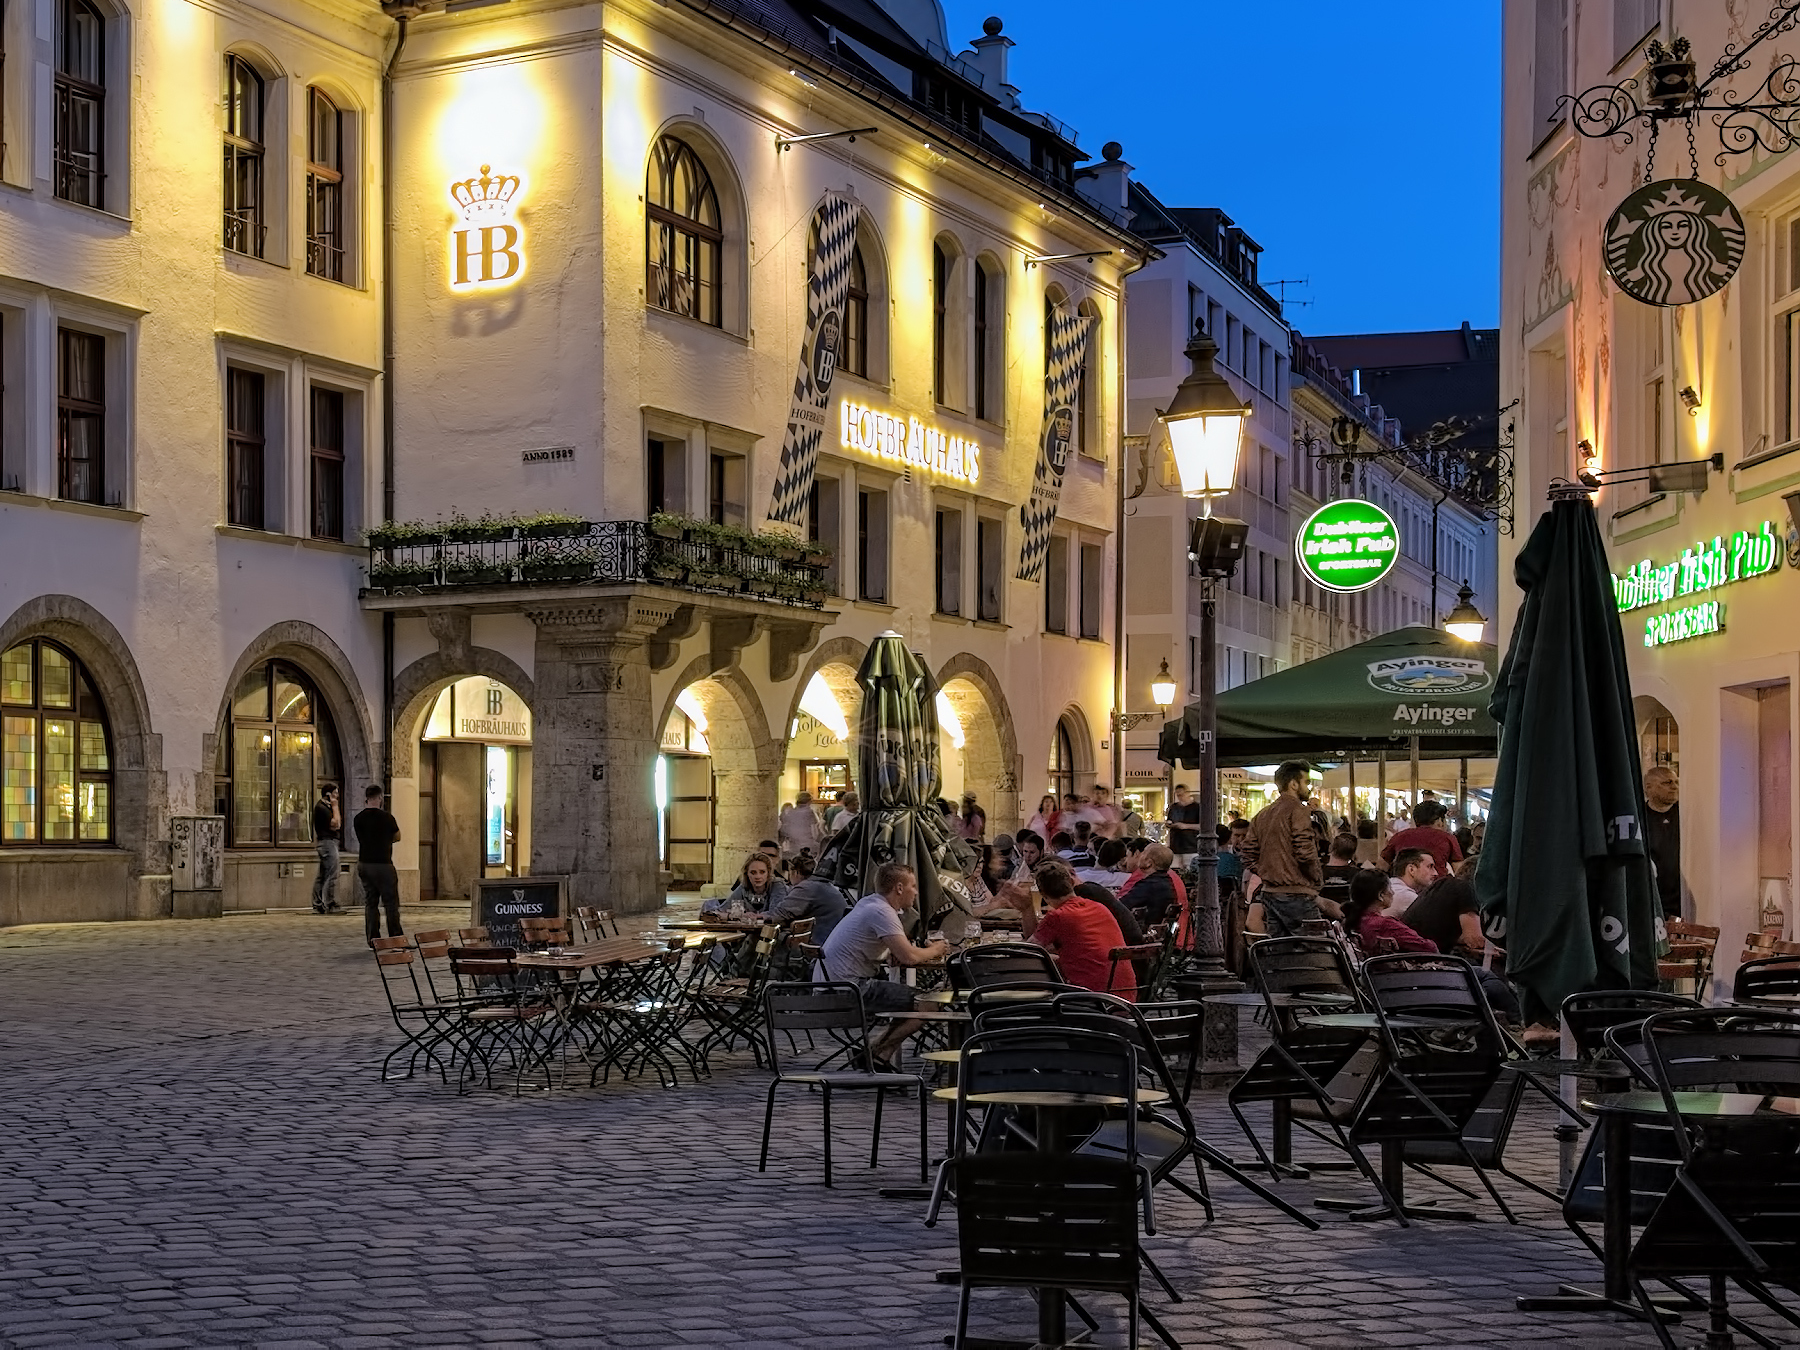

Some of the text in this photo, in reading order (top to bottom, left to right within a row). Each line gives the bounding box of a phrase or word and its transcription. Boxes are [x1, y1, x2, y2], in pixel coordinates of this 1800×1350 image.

[453, 224, 520, 286] HB
[817, 349, 835, 384] HB
[840, 400, 981, 484] HOFBRÄUHAUS
[522, 449, 573, 462] ANNO 1589
[1053, 439, 1069, 467] HB
[1313, 519, 1388, 536] Dubliner
[1305, 535, 1395, 555] Irish Pub
[1318, 558, 1382, 570] SPORTSBAR
[1680, 541, 1727, 596] Irish
[1729, 520, 1776, 581] Pub
[1644, 600, 1719, 648] SPORTSBAR
[1377, 658, 1478, 672] Ayinger
[1381, 681, 1482, 693] PRIVATBRAUEREI
[486, 689, 503, 716] HB
[1393, 703, 1477, 726] Ayinger
[461, 717, 527, 737] HOFBRÄUHAUS
[494, 902, 544, 915] GUINNESS
